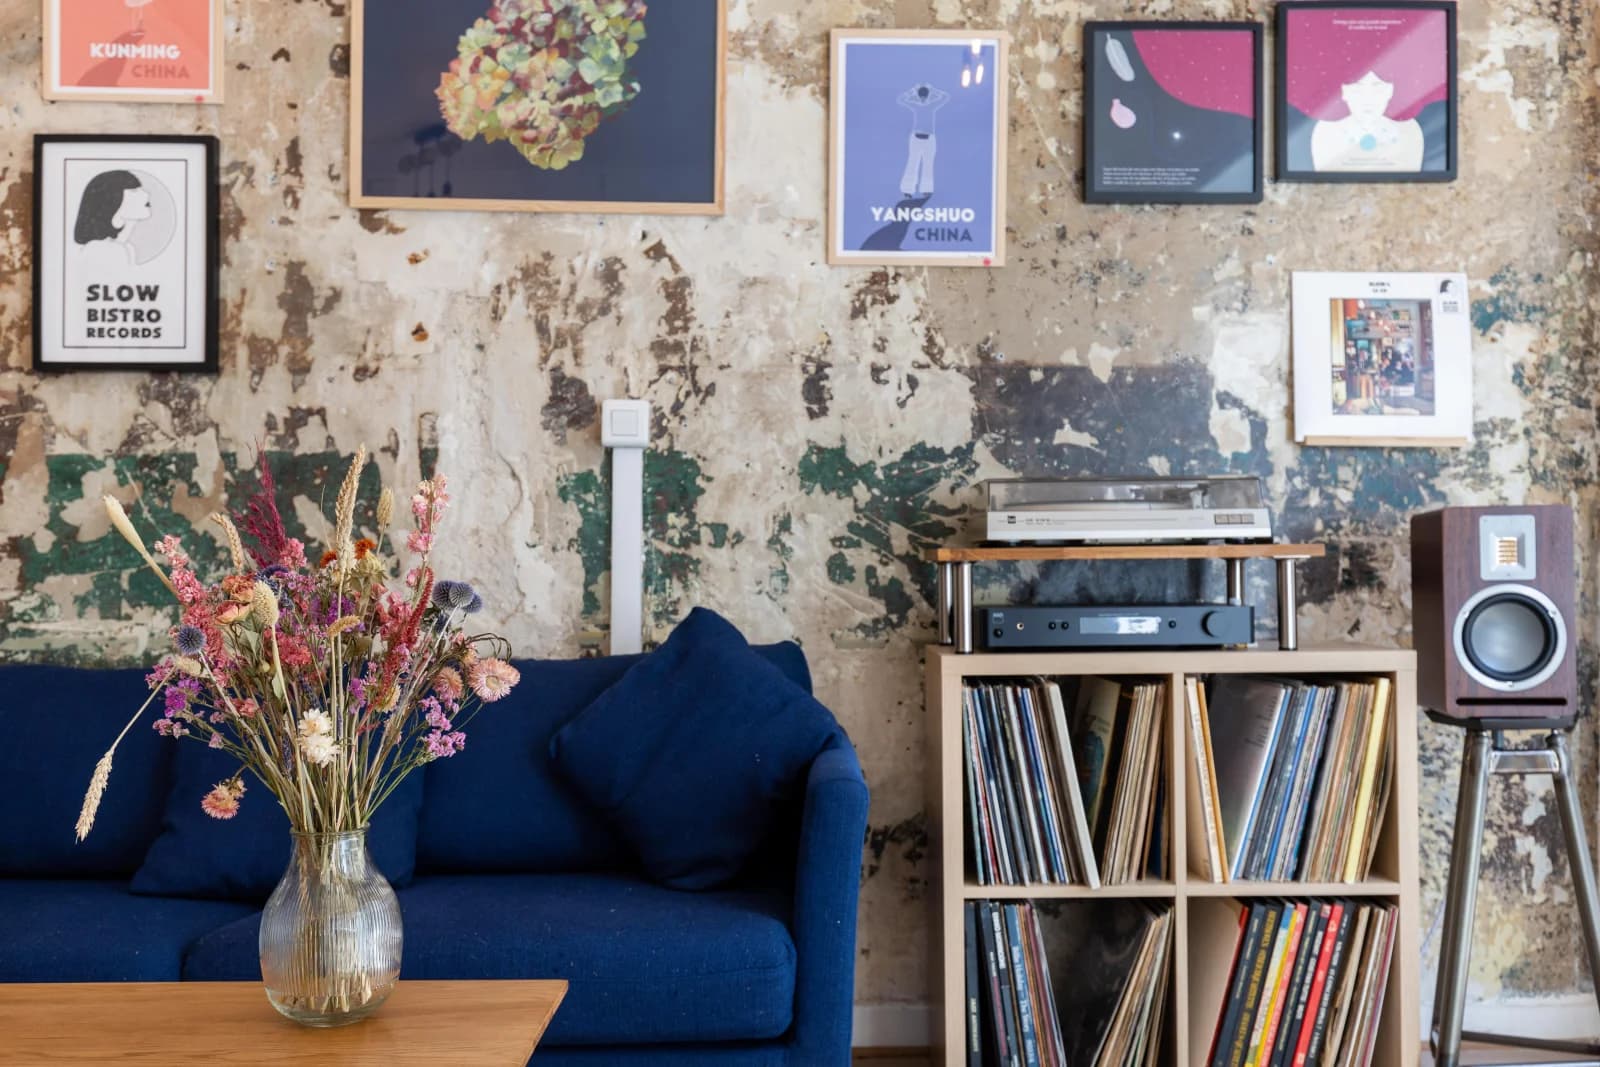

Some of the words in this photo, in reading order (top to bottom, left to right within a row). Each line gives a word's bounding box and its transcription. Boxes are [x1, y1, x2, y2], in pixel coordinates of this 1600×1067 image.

[89, 43, 181, 60] KUNMING
[131, 64, 190, 78] CHINA
[871, 207, 975, 223] YANGSHUO
[914, 227, 973, 242] CHINA
[87, 284, 160, 302] SLOW
[87, 308, 161, 322] BISTRO
[87, 327, 162, 338] RECORDS
